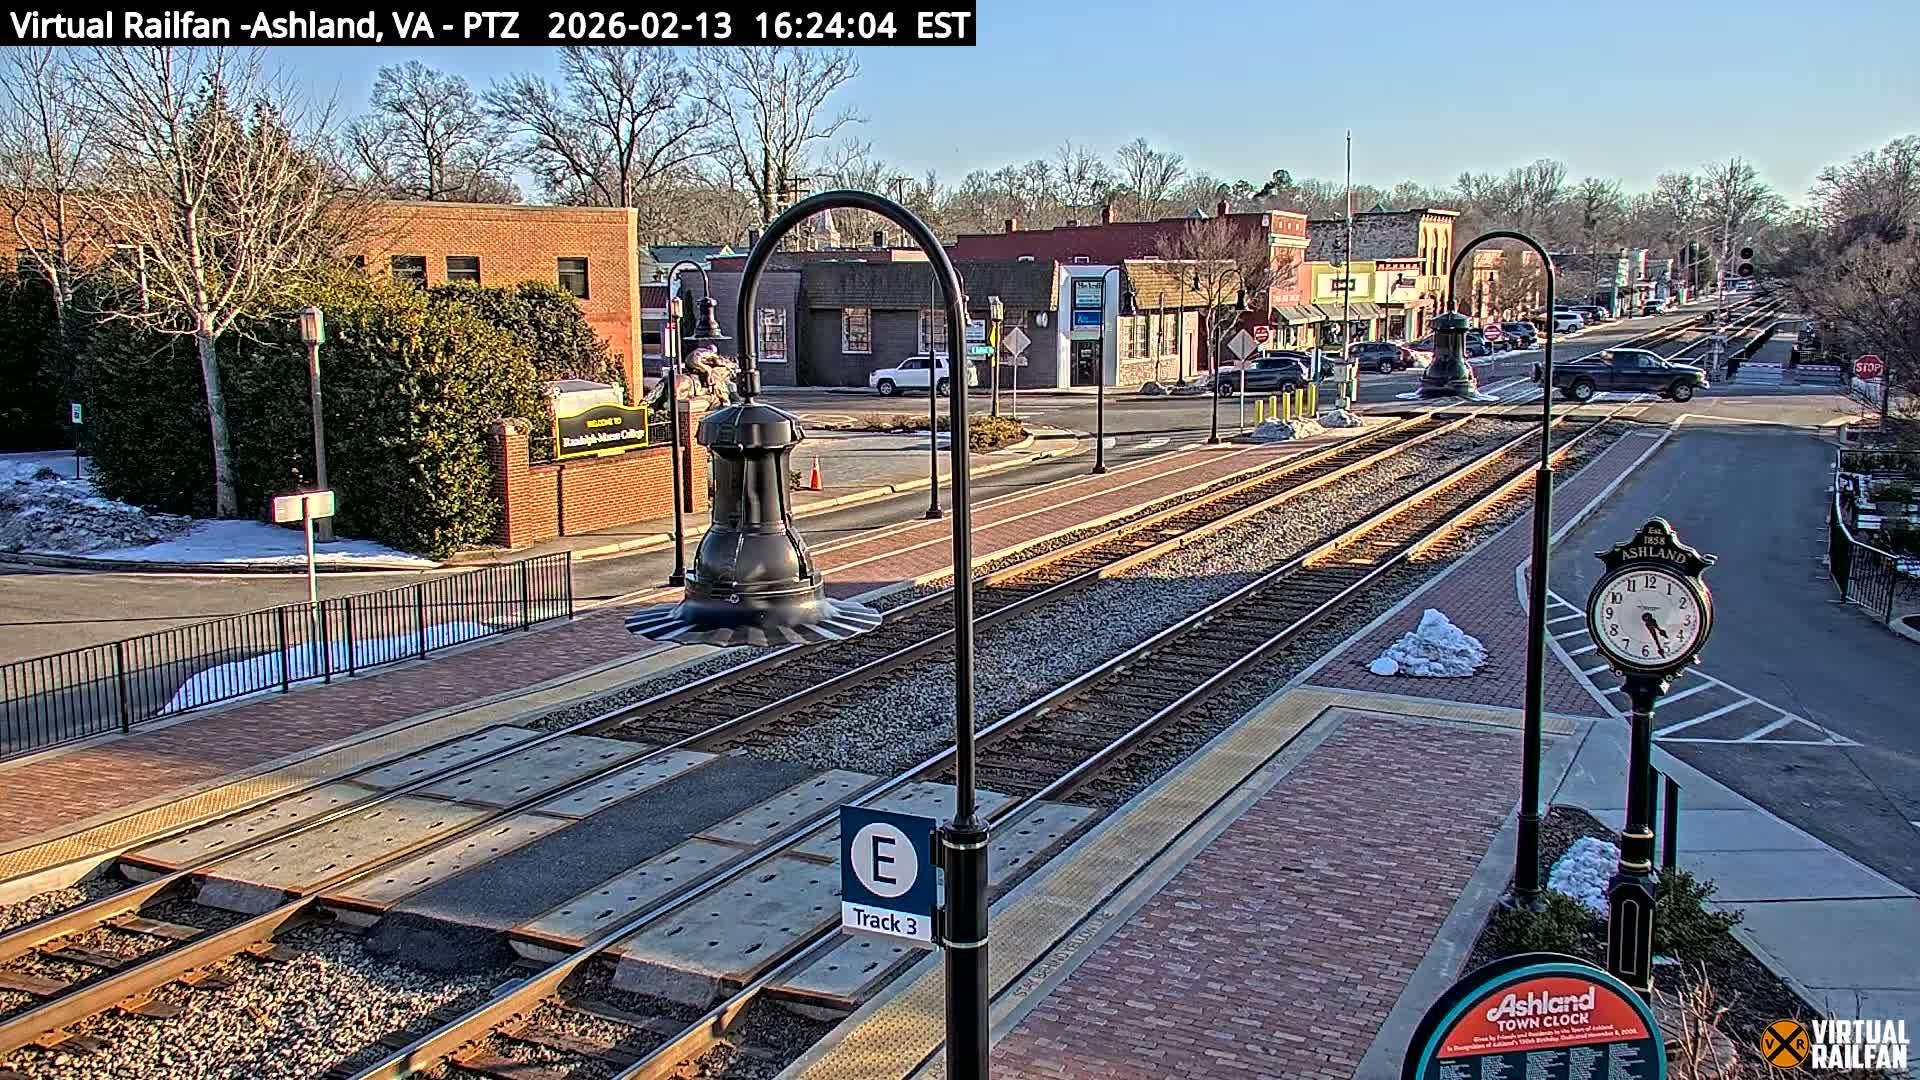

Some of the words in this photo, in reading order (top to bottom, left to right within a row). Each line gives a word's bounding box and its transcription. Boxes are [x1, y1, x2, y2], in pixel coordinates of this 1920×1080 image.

[1855, 362, 1881, 373] STOP
[1644, 536, 1665, 545] 1858
[1622, 546, 1687, 564] ASHLAND
[1627, 579, 1636, 592] 11
[1644, 576, 1657, 589] 12
[1667, 583, 1672, 596] 1
[1611, 592, 1623, 605] 10
[1679, 597, 1688, 609] 2
[1606, 607, 1614, 620] 9
[1684, 615, 1691, 626] 3
[1610, 624, 1618, 636] 8
[1677, 629, 1684, 642] 4
[1622, 639, 1630, 650] 7
[1641, 645, 1649, 657] 6
[871, 835, 897, 885] E
[853, 907, 901, 933] Track
[906, 917, 918, 935] 3
[1487, 986, 1596, 1022] Ashland
[1497, 1018, 1540, 1032] TOWN
[1543, 1012, 1590, 1028] CLOCK
